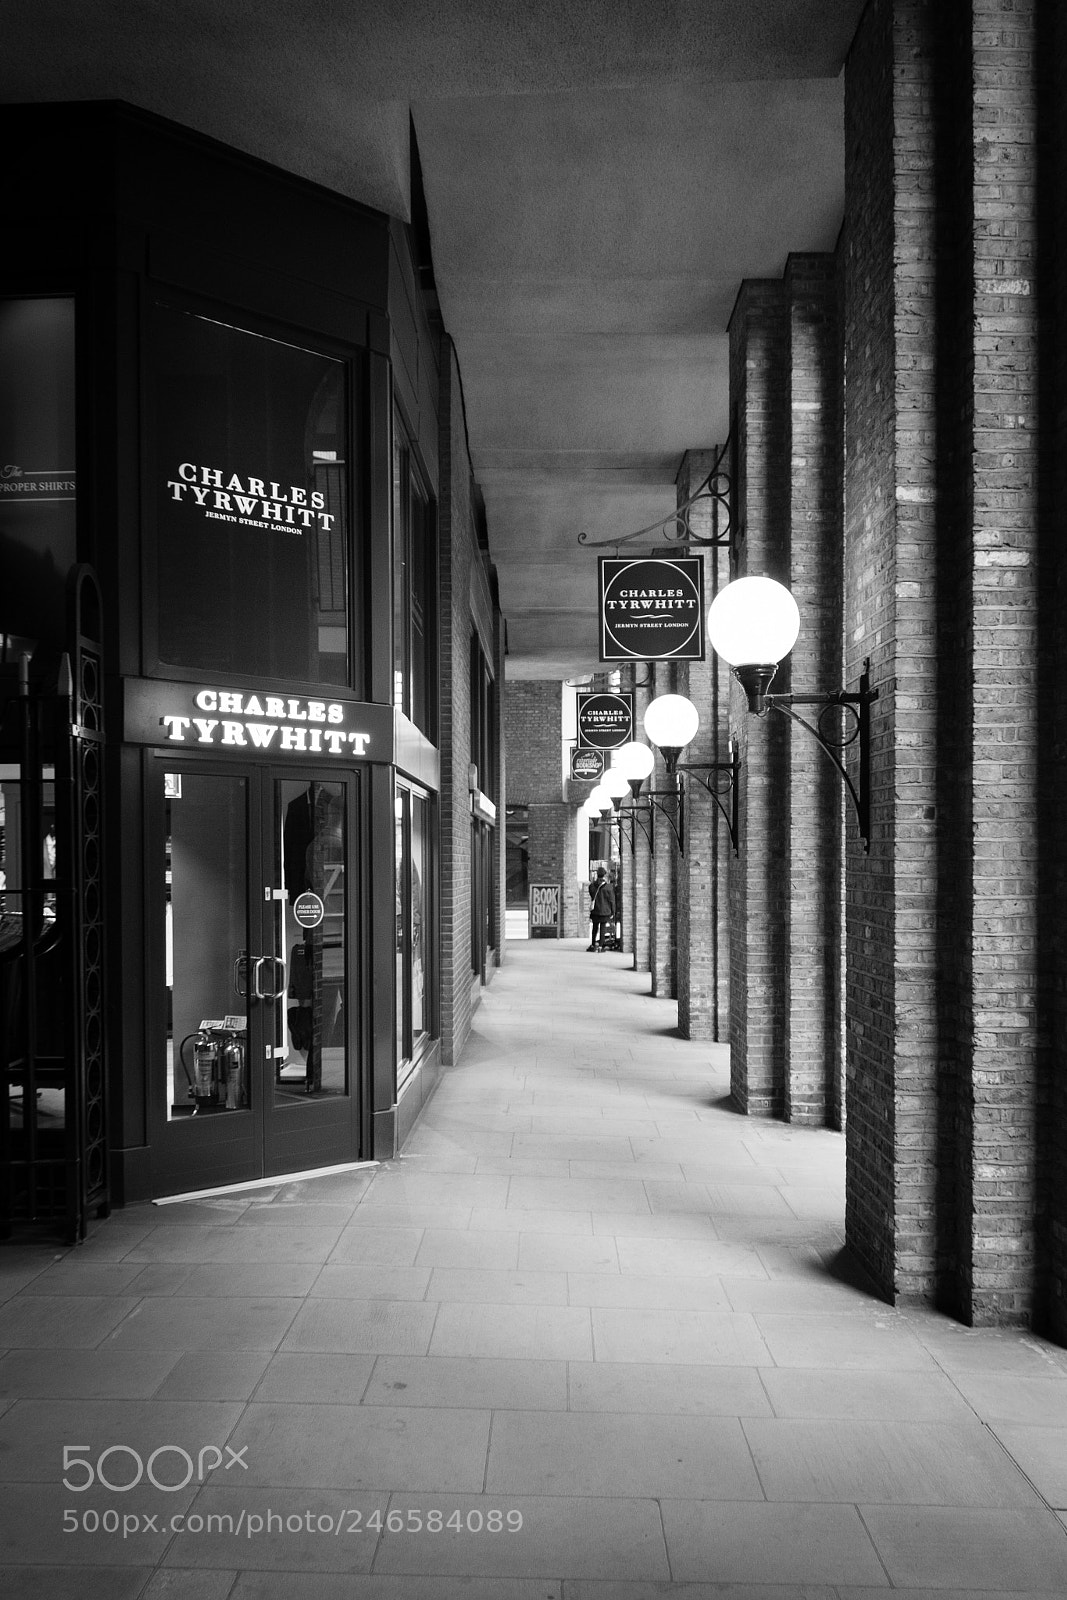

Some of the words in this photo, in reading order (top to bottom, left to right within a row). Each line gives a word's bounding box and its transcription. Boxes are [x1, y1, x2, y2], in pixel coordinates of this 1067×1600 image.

[1, 464, 23, 479] The
[0, 482, 37, 492] PROPER
[38, 480, 76, 491] SHIRTS
[178, 462, 326, 510] CHARLES
[167, 480, 335, 532] TYRWHITT
[205, 510, 237, 523] JERMYN
[238, 517, 269, 530] STREET
[270, 523, 303, 536] LONDON
[620, 589, 684, 598] CHARLES
[607, 599, 696, 610] TYRWHITT
[194, 690, 344, 724] CHARLES
[160, 715, 371, 756] TYRWHITT
[533, 888, 558, 905] BOOK
